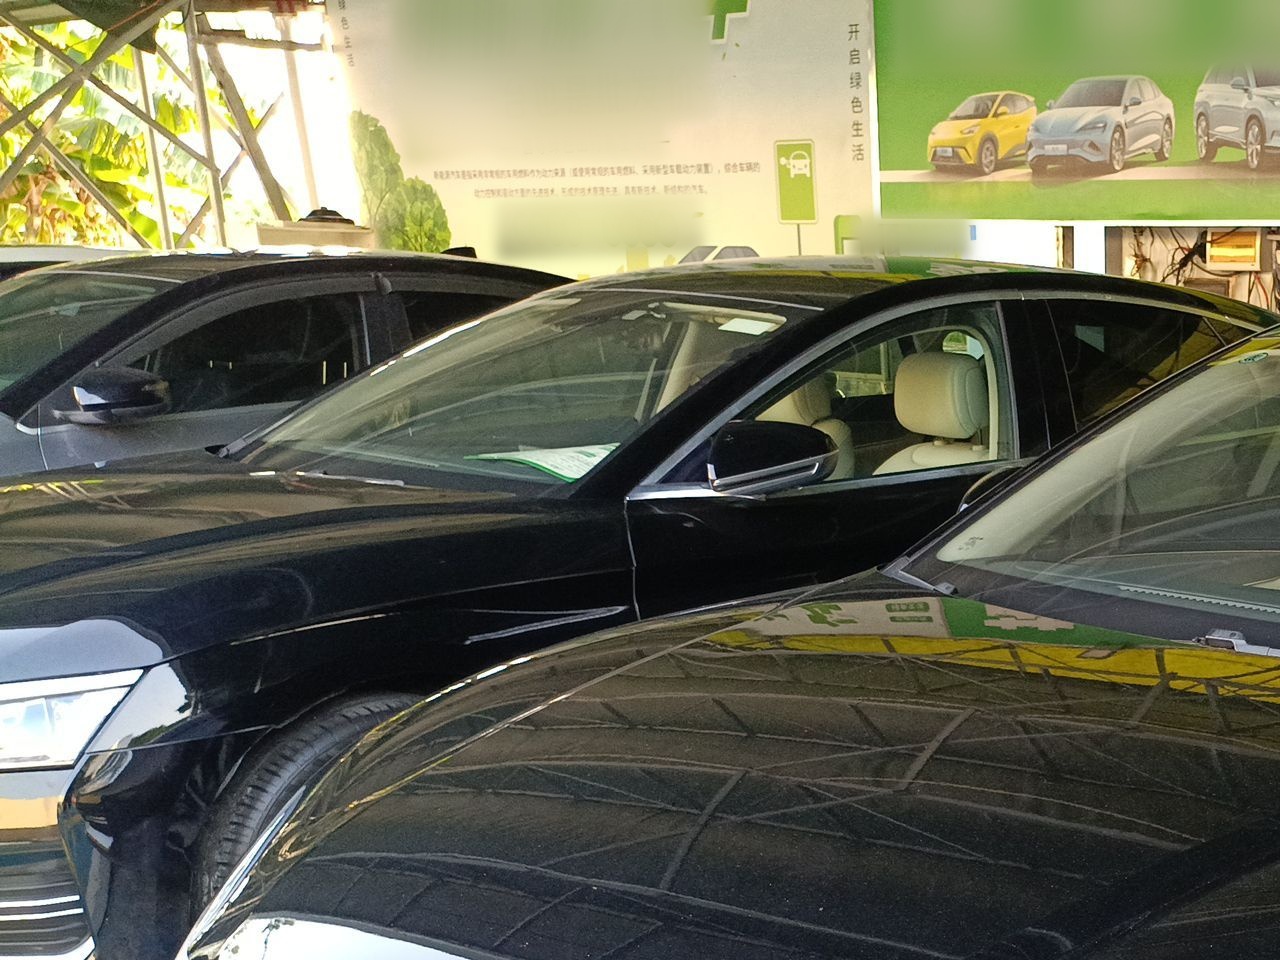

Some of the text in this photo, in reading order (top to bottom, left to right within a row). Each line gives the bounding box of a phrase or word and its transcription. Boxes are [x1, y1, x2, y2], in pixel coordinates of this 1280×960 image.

[848, 23, 864, 161] 开启绿色生活
